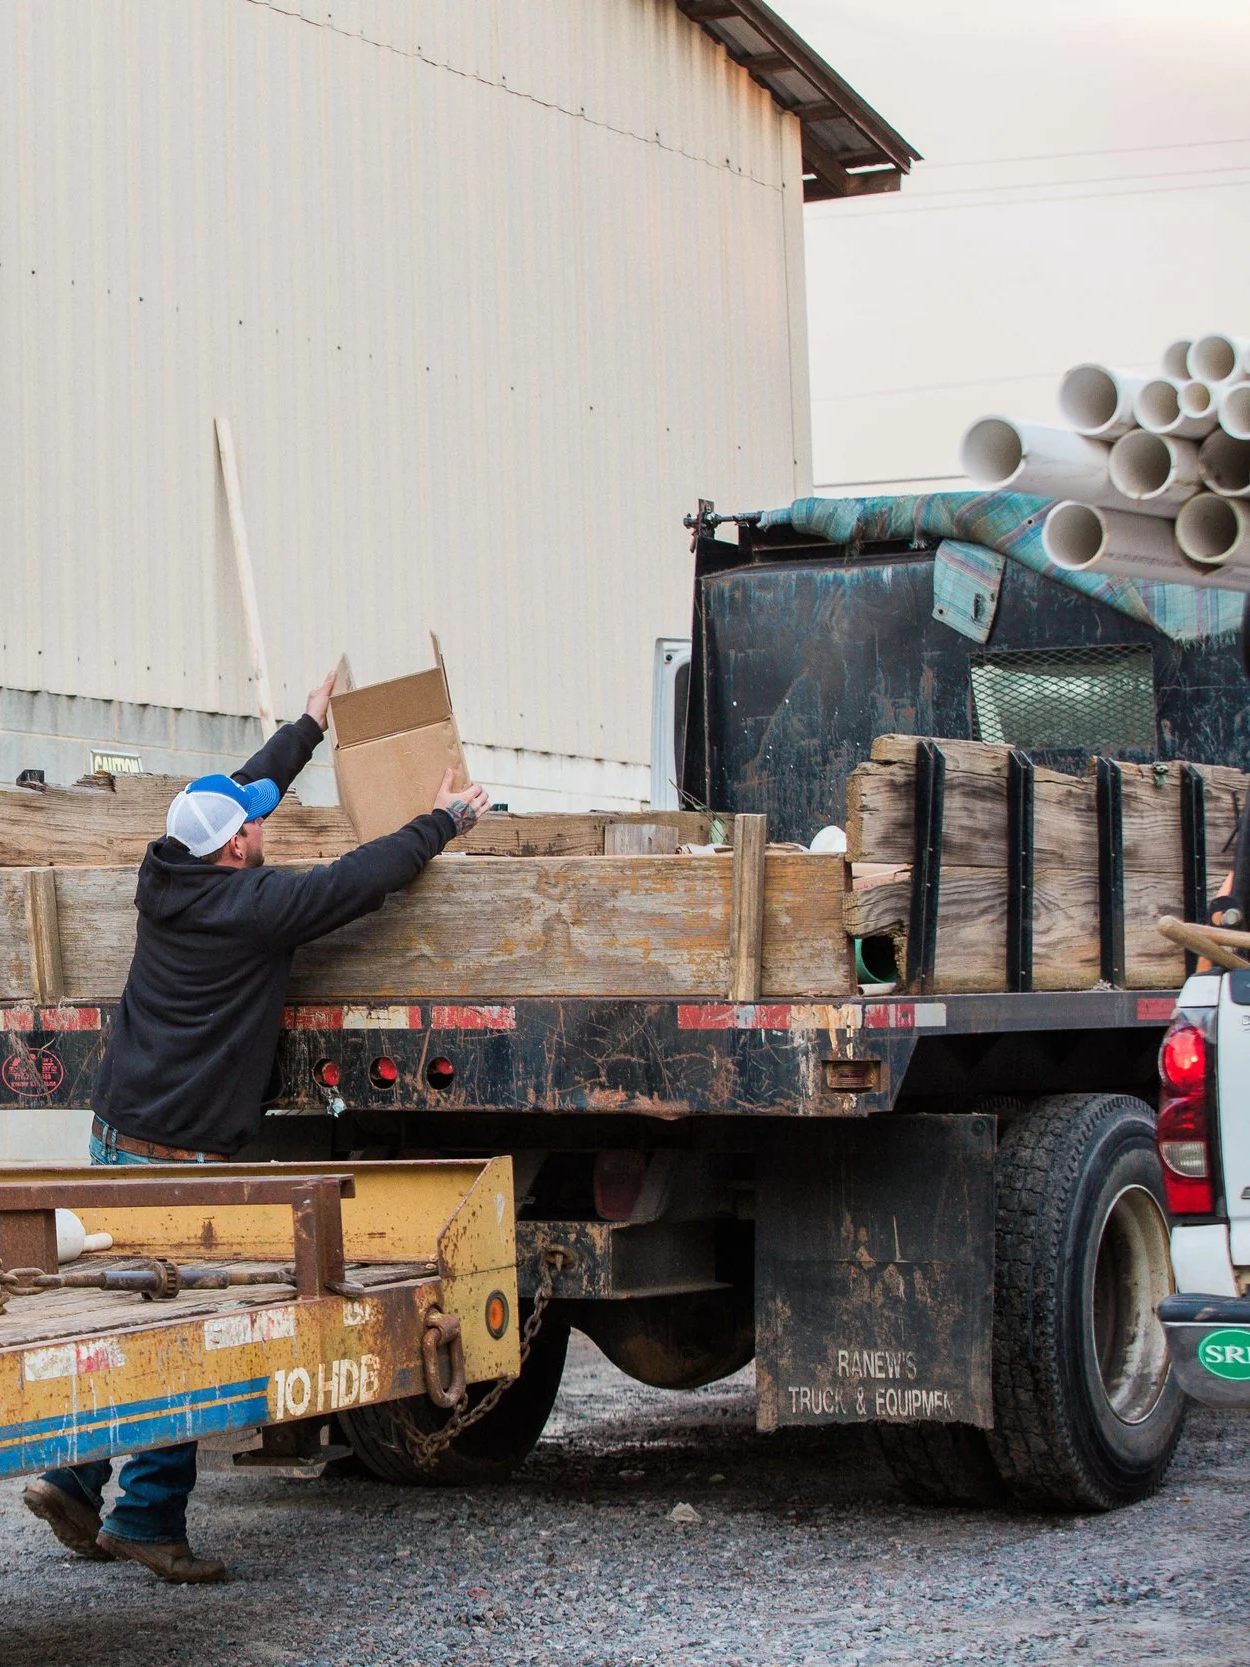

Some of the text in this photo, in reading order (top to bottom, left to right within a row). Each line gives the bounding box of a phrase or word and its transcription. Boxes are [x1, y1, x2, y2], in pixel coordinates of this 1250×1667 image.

[94, 755, 140, 772] CAUTION
[838, 1350, 917, 1379] RANEW'S
[275, 1354, 379, 1420] 10 HDB
[788, 1386, 954, 1416] TRUCK & EQUIPMEN
